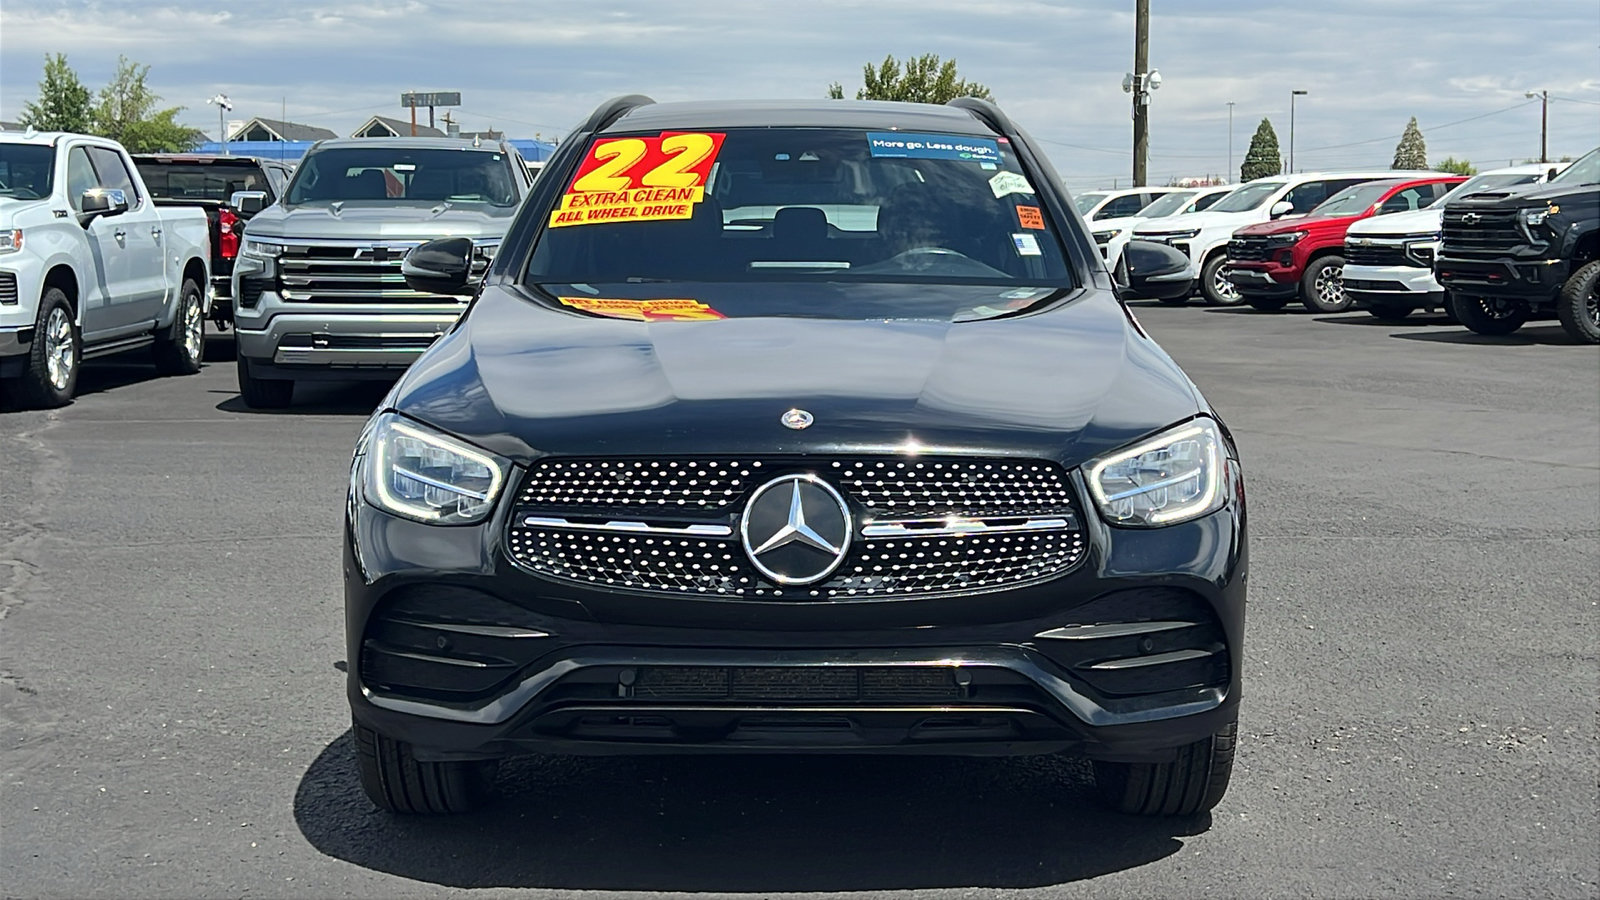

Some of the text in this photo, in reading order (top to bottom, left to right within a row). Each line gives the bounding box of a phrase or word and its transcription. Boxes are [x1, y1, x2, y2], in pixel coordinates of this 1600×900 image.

[873, 140, 995, 154] More go. Less dough.
[573, 133, 715, 192] 22
[568, 187, 694, 208] EXTRA CLEAN
[555, 204, 688, 224] ALL WHEEL DRIVE
